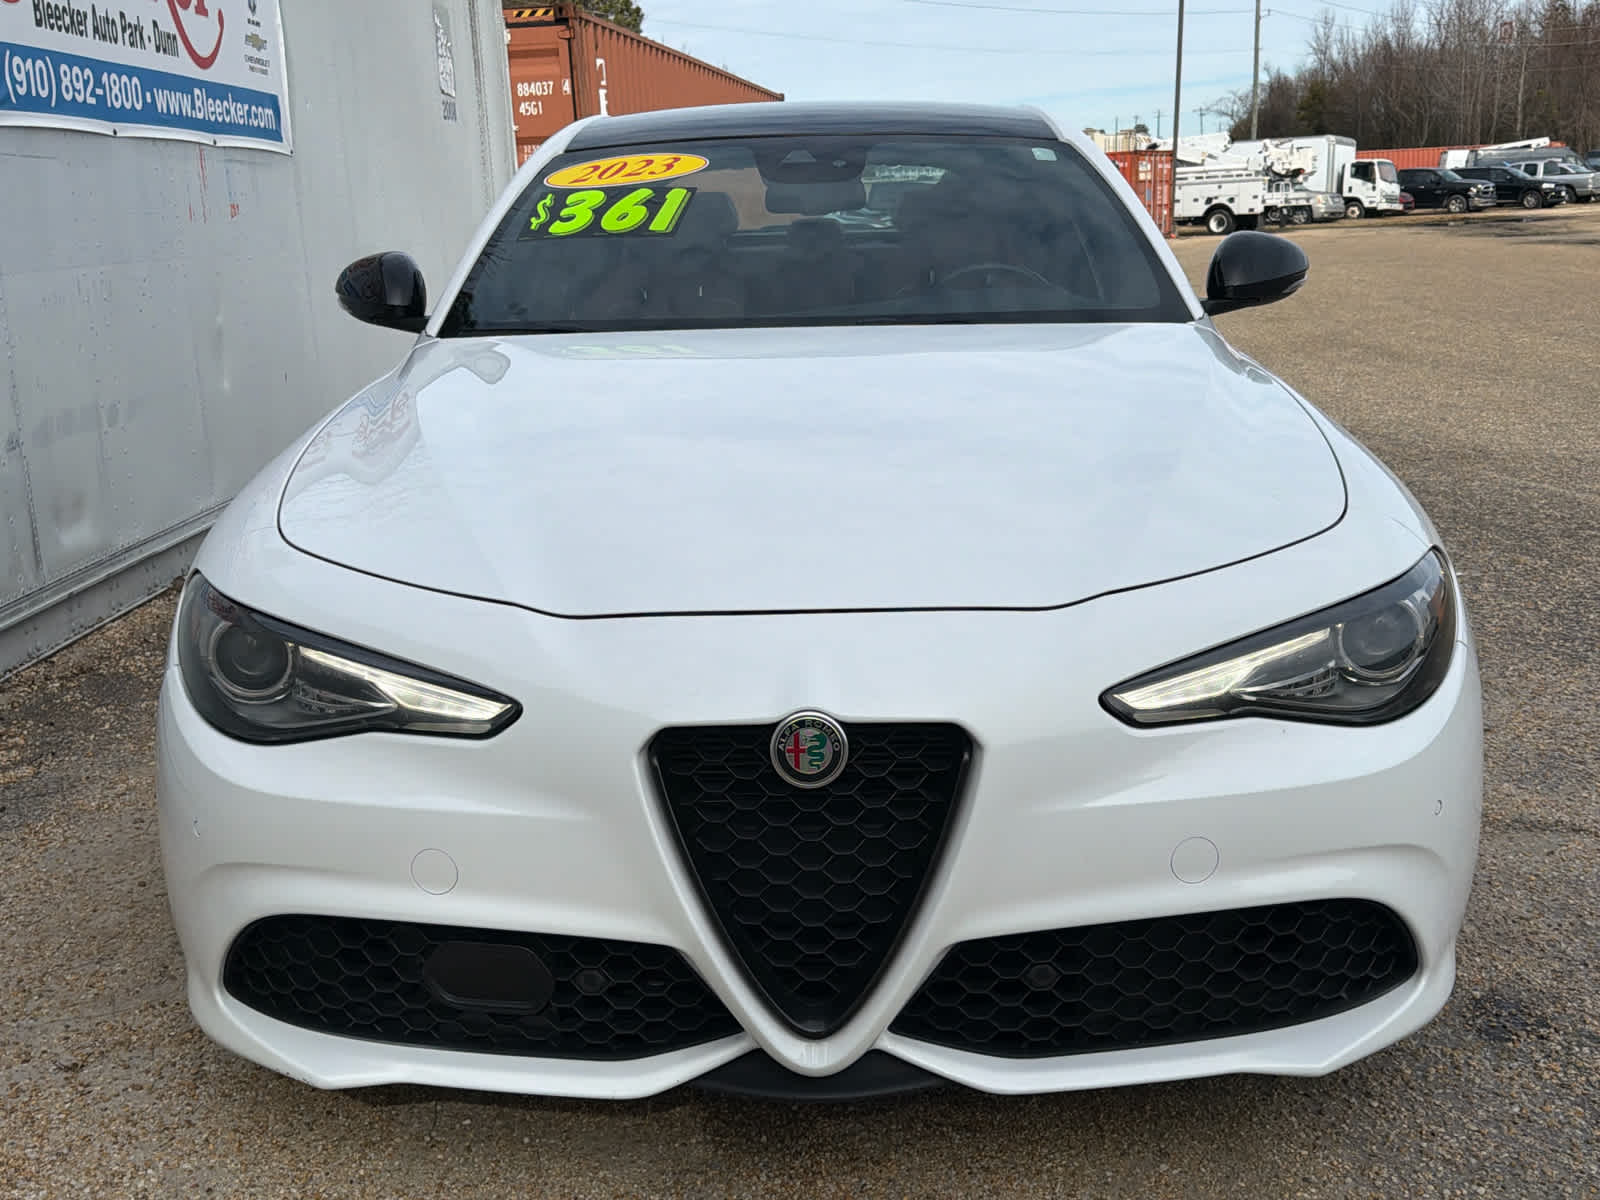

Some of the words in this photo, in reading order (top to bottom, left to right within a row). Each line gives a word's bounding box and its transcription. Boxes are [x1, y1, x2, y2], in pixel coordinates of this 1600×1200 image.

[32, 0, 88, 38] Bleecker
[92, 3, 119, 45] Auto
[119, 10, 146, 51] Park
[152, 18, 180, 57] Dunn
[4, 49, 57, 108] (910)
[59, 63, 143, 111] 892-1800
[153, 87, 276, 130] www.Bleecker.com
[517, 81, 554, 97] 884037
[519, 101, 543, 116] 45G1
[568, 157, 681, 184] 2023
[530, 187, 692, 236] $361
[778, 723, 800, 752] ALFA
[805, 719, 841, 752] ROMEO
